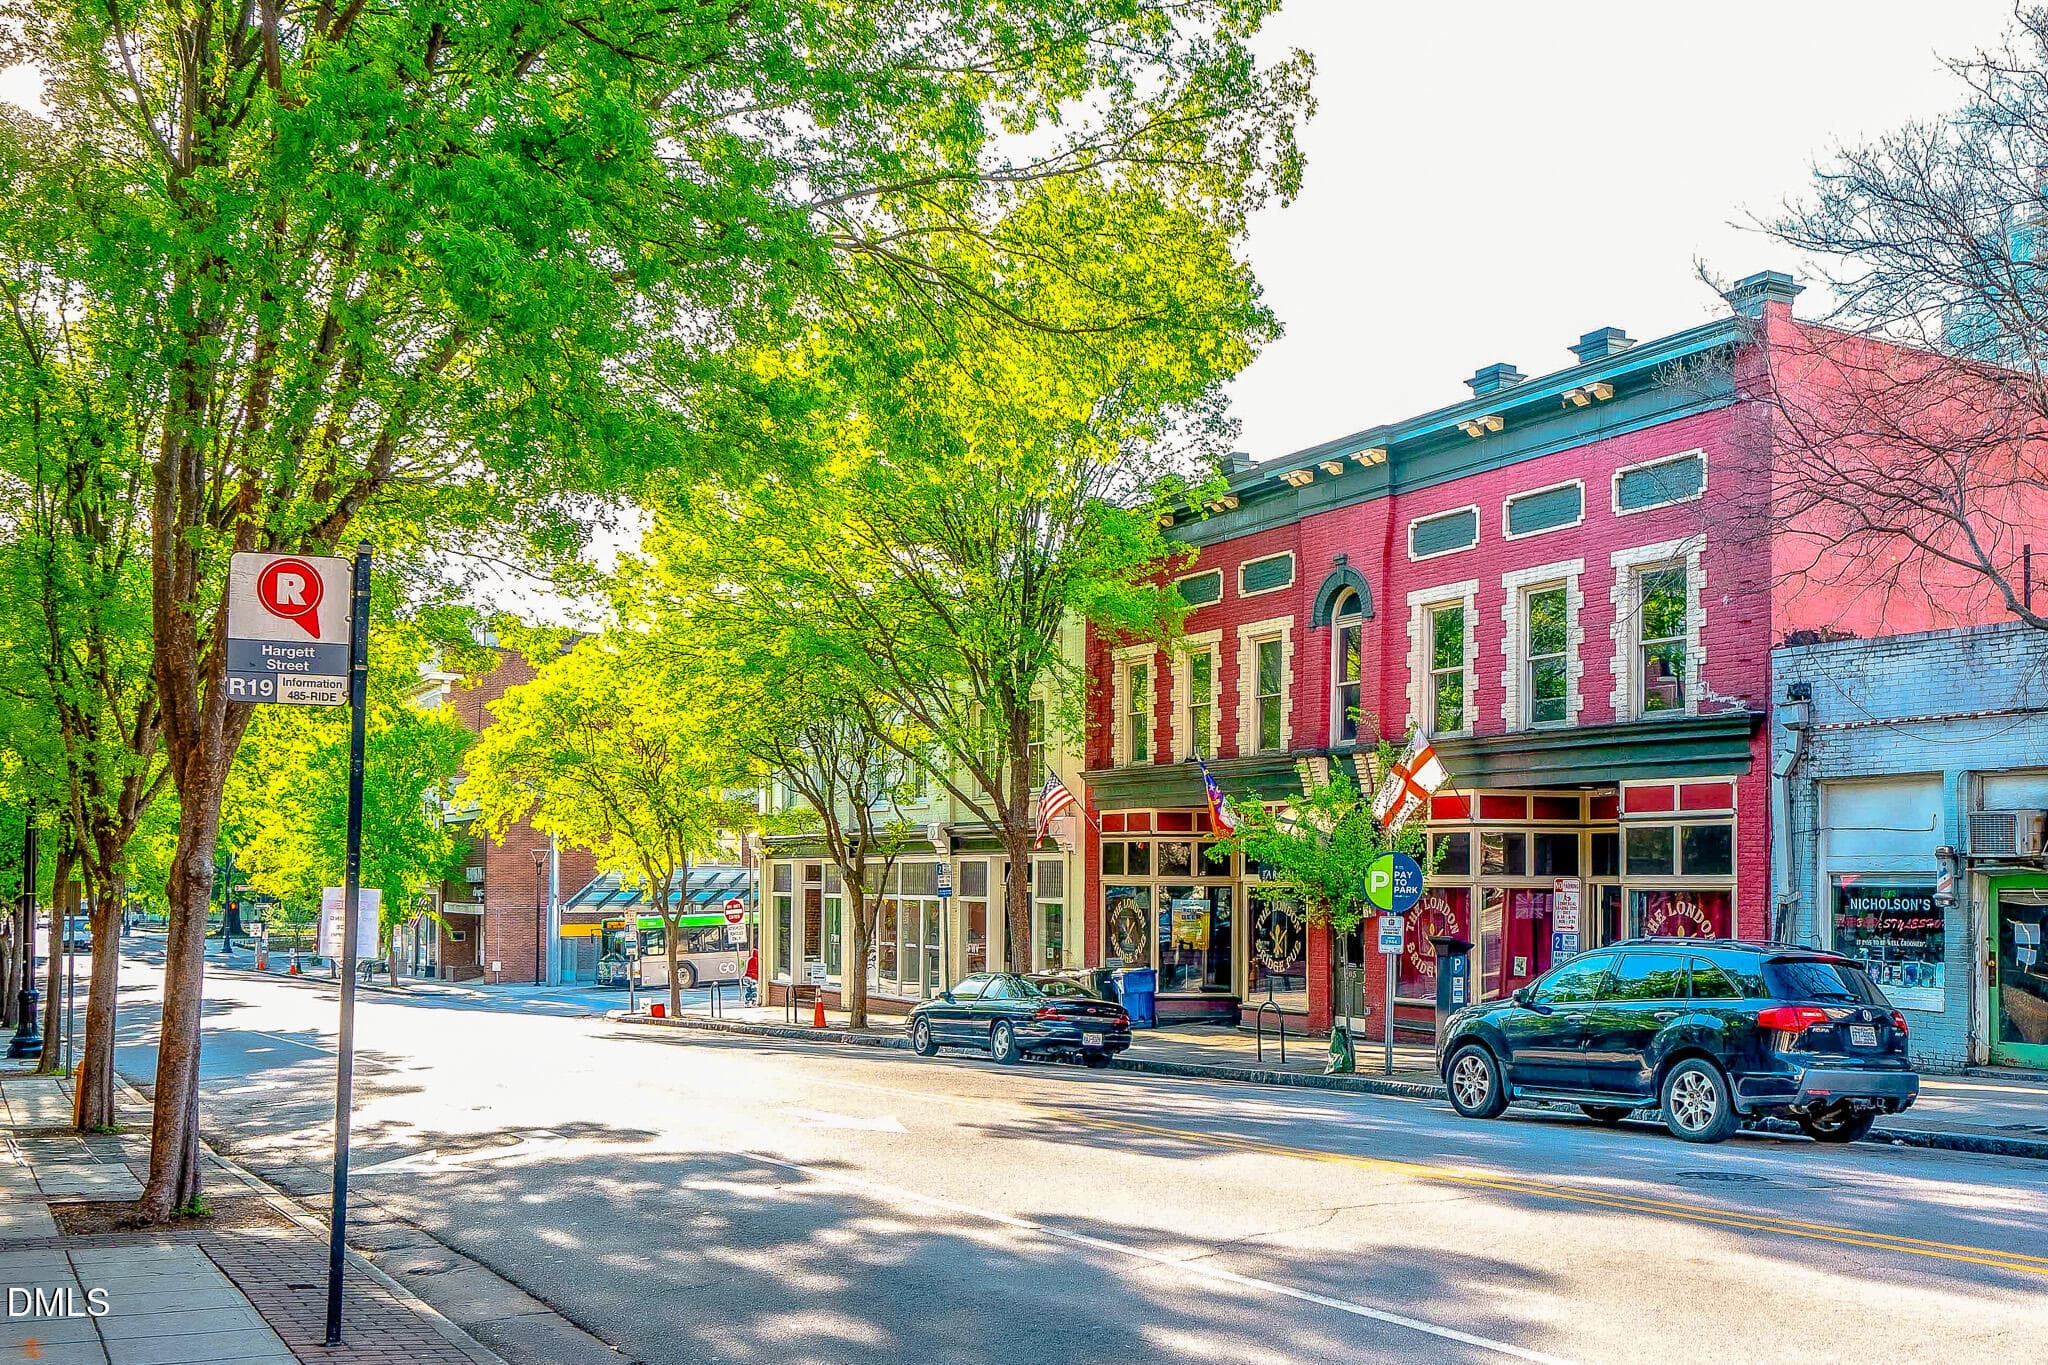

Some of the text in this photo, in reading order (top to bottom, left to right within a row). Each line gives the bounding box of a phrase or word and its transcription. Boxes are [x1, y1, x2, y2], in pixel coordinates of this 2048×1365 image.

[276, 572, 307, 606] R
[261, 644, 316, 658] Hargett
[266, 658, 310, 672] Street
[229, 677, 274, 696] R19
[282, 677, 343, 689] Information
[287, 691, 337, 702] 485-RIDE
[1370, 870, 1390, 893] P
[1394, 871, 1413, 879] PAY
[1394, 878, 1408, 886] TO
[1393, 886, 1418, 894] PARK
[1849, 898, 1932, 911] NICHOLSON'S
[1110, 897, 1147, 929] THE LONDON
[1255, 900, 1302, 934] THE LONDON
[1405, 897, 1460, 935] THE LONDON
[1110, 933, 1147, 964] BRIDGE PUB
[1555, 936, 1560, 949] 2
[1255, 938, 1302, 973] BRIDGE PUB
[1406, 941, 1437, 978] BRIDG
[719, 961, 737, 974] GO
[1454, 958, 1462, 971] P
